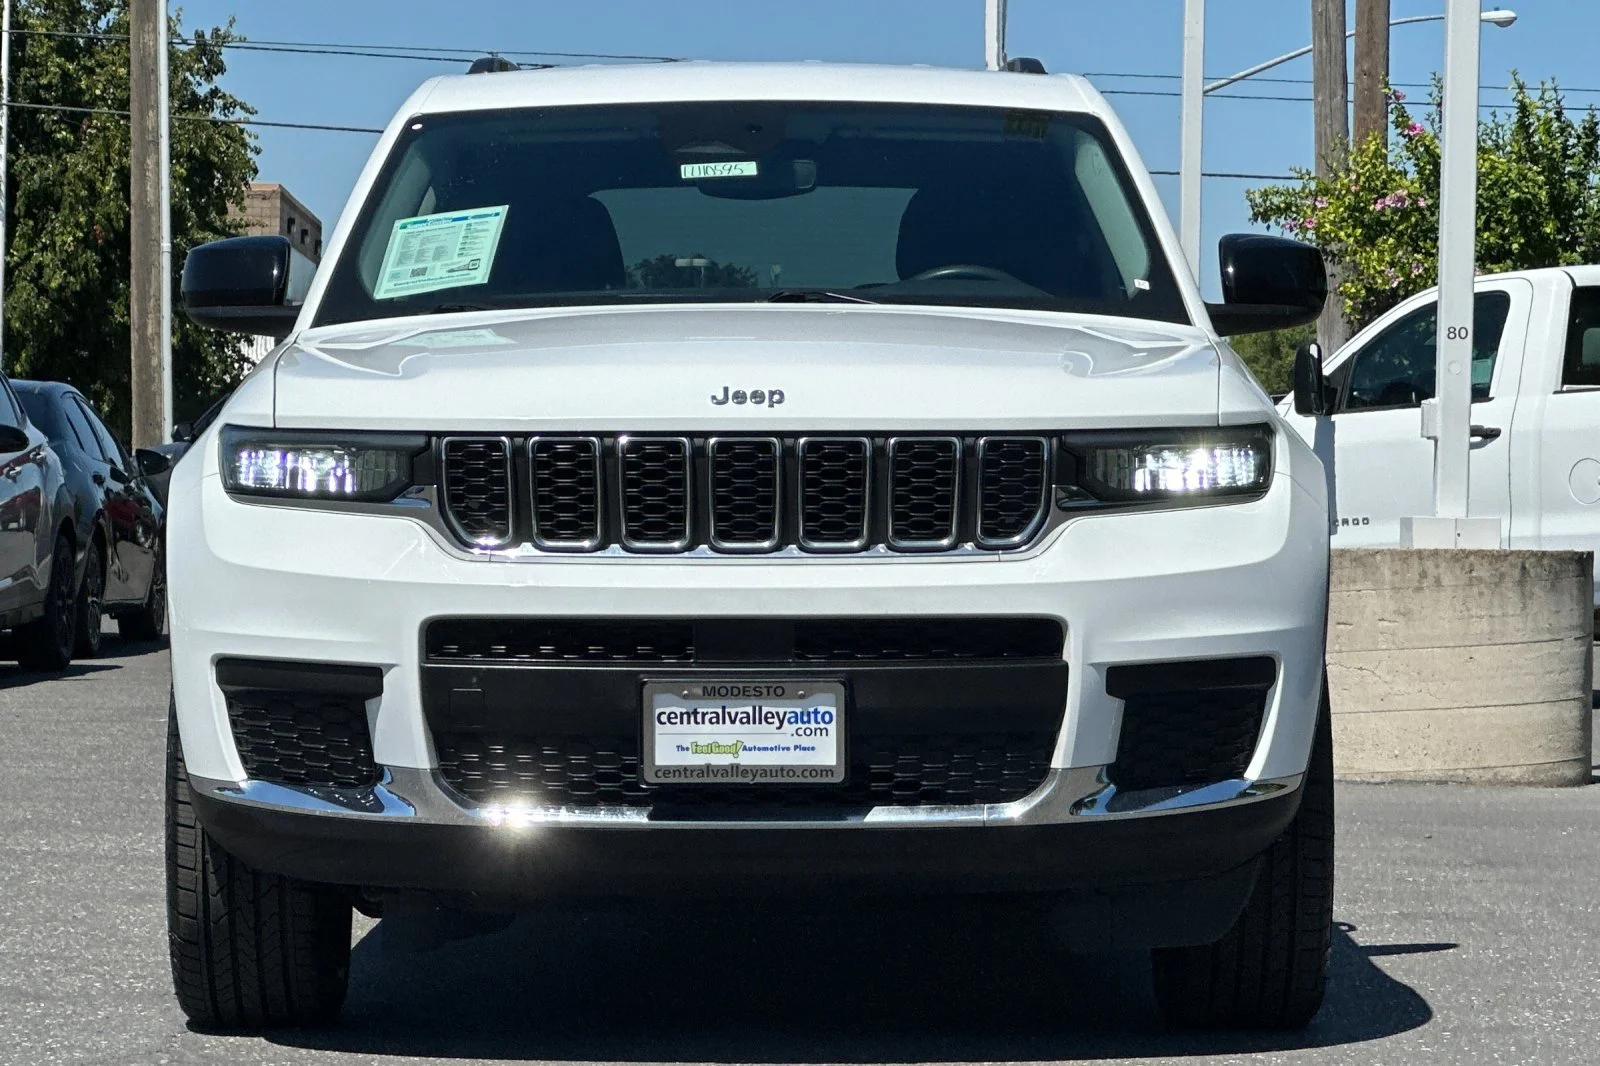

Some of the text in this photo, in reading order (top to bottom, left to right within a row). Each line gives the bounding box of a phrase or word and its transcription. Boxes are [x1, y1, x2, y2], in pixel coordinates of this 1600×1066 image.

[1447, 326, 1469, 340] 80
[711, 386, 785, 408] Jeep
[702, 685, 785, 698] MODESTO
[656, 705, 834, 730] centralvalleyauto
[790, 726, 829, 737] .com
[676, 744, 690, 752] The
[742, 744, 791, 752] Automotive
[793, 744, 816, 752] Place
[654, 762, 835, 781] centralvalleyauto.com
